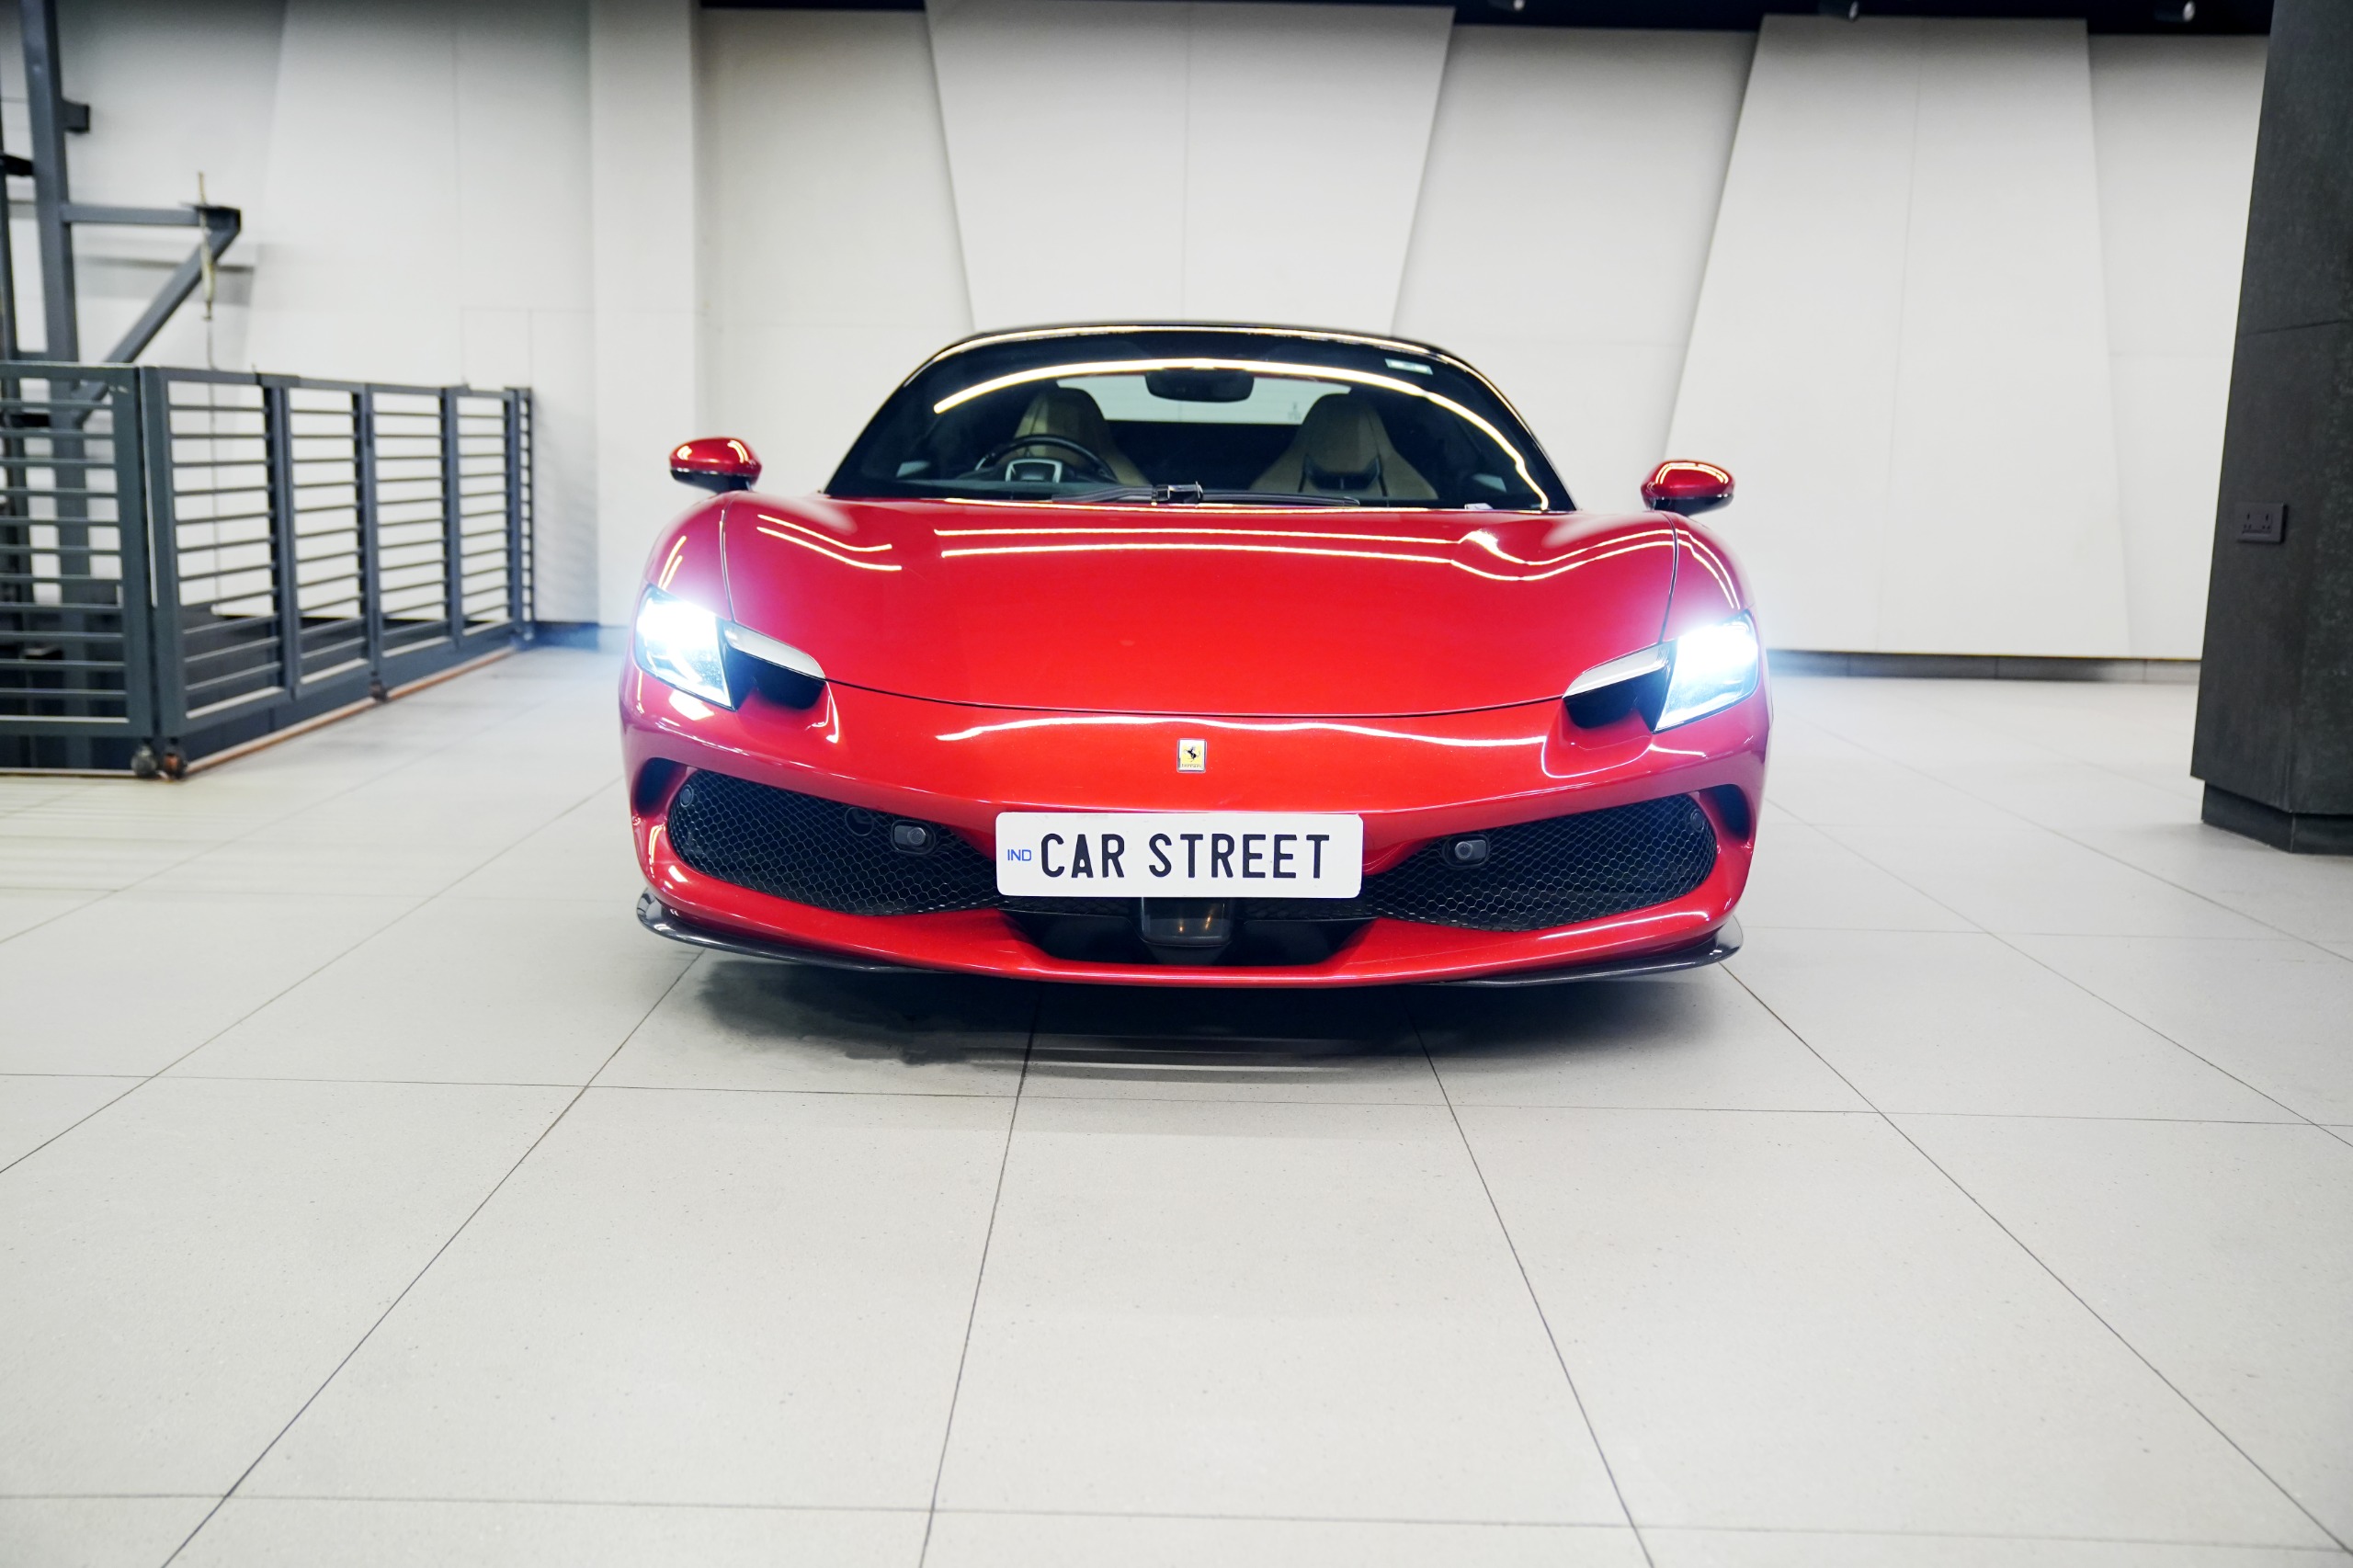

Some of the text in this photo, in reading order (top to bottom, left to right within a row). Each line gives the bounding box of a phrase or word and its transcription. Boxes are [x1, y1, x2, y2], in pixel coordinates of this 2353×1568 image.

[1007, 848, 1032, 862] IND
[1040, 833, 1330, 880] CAR STREET
